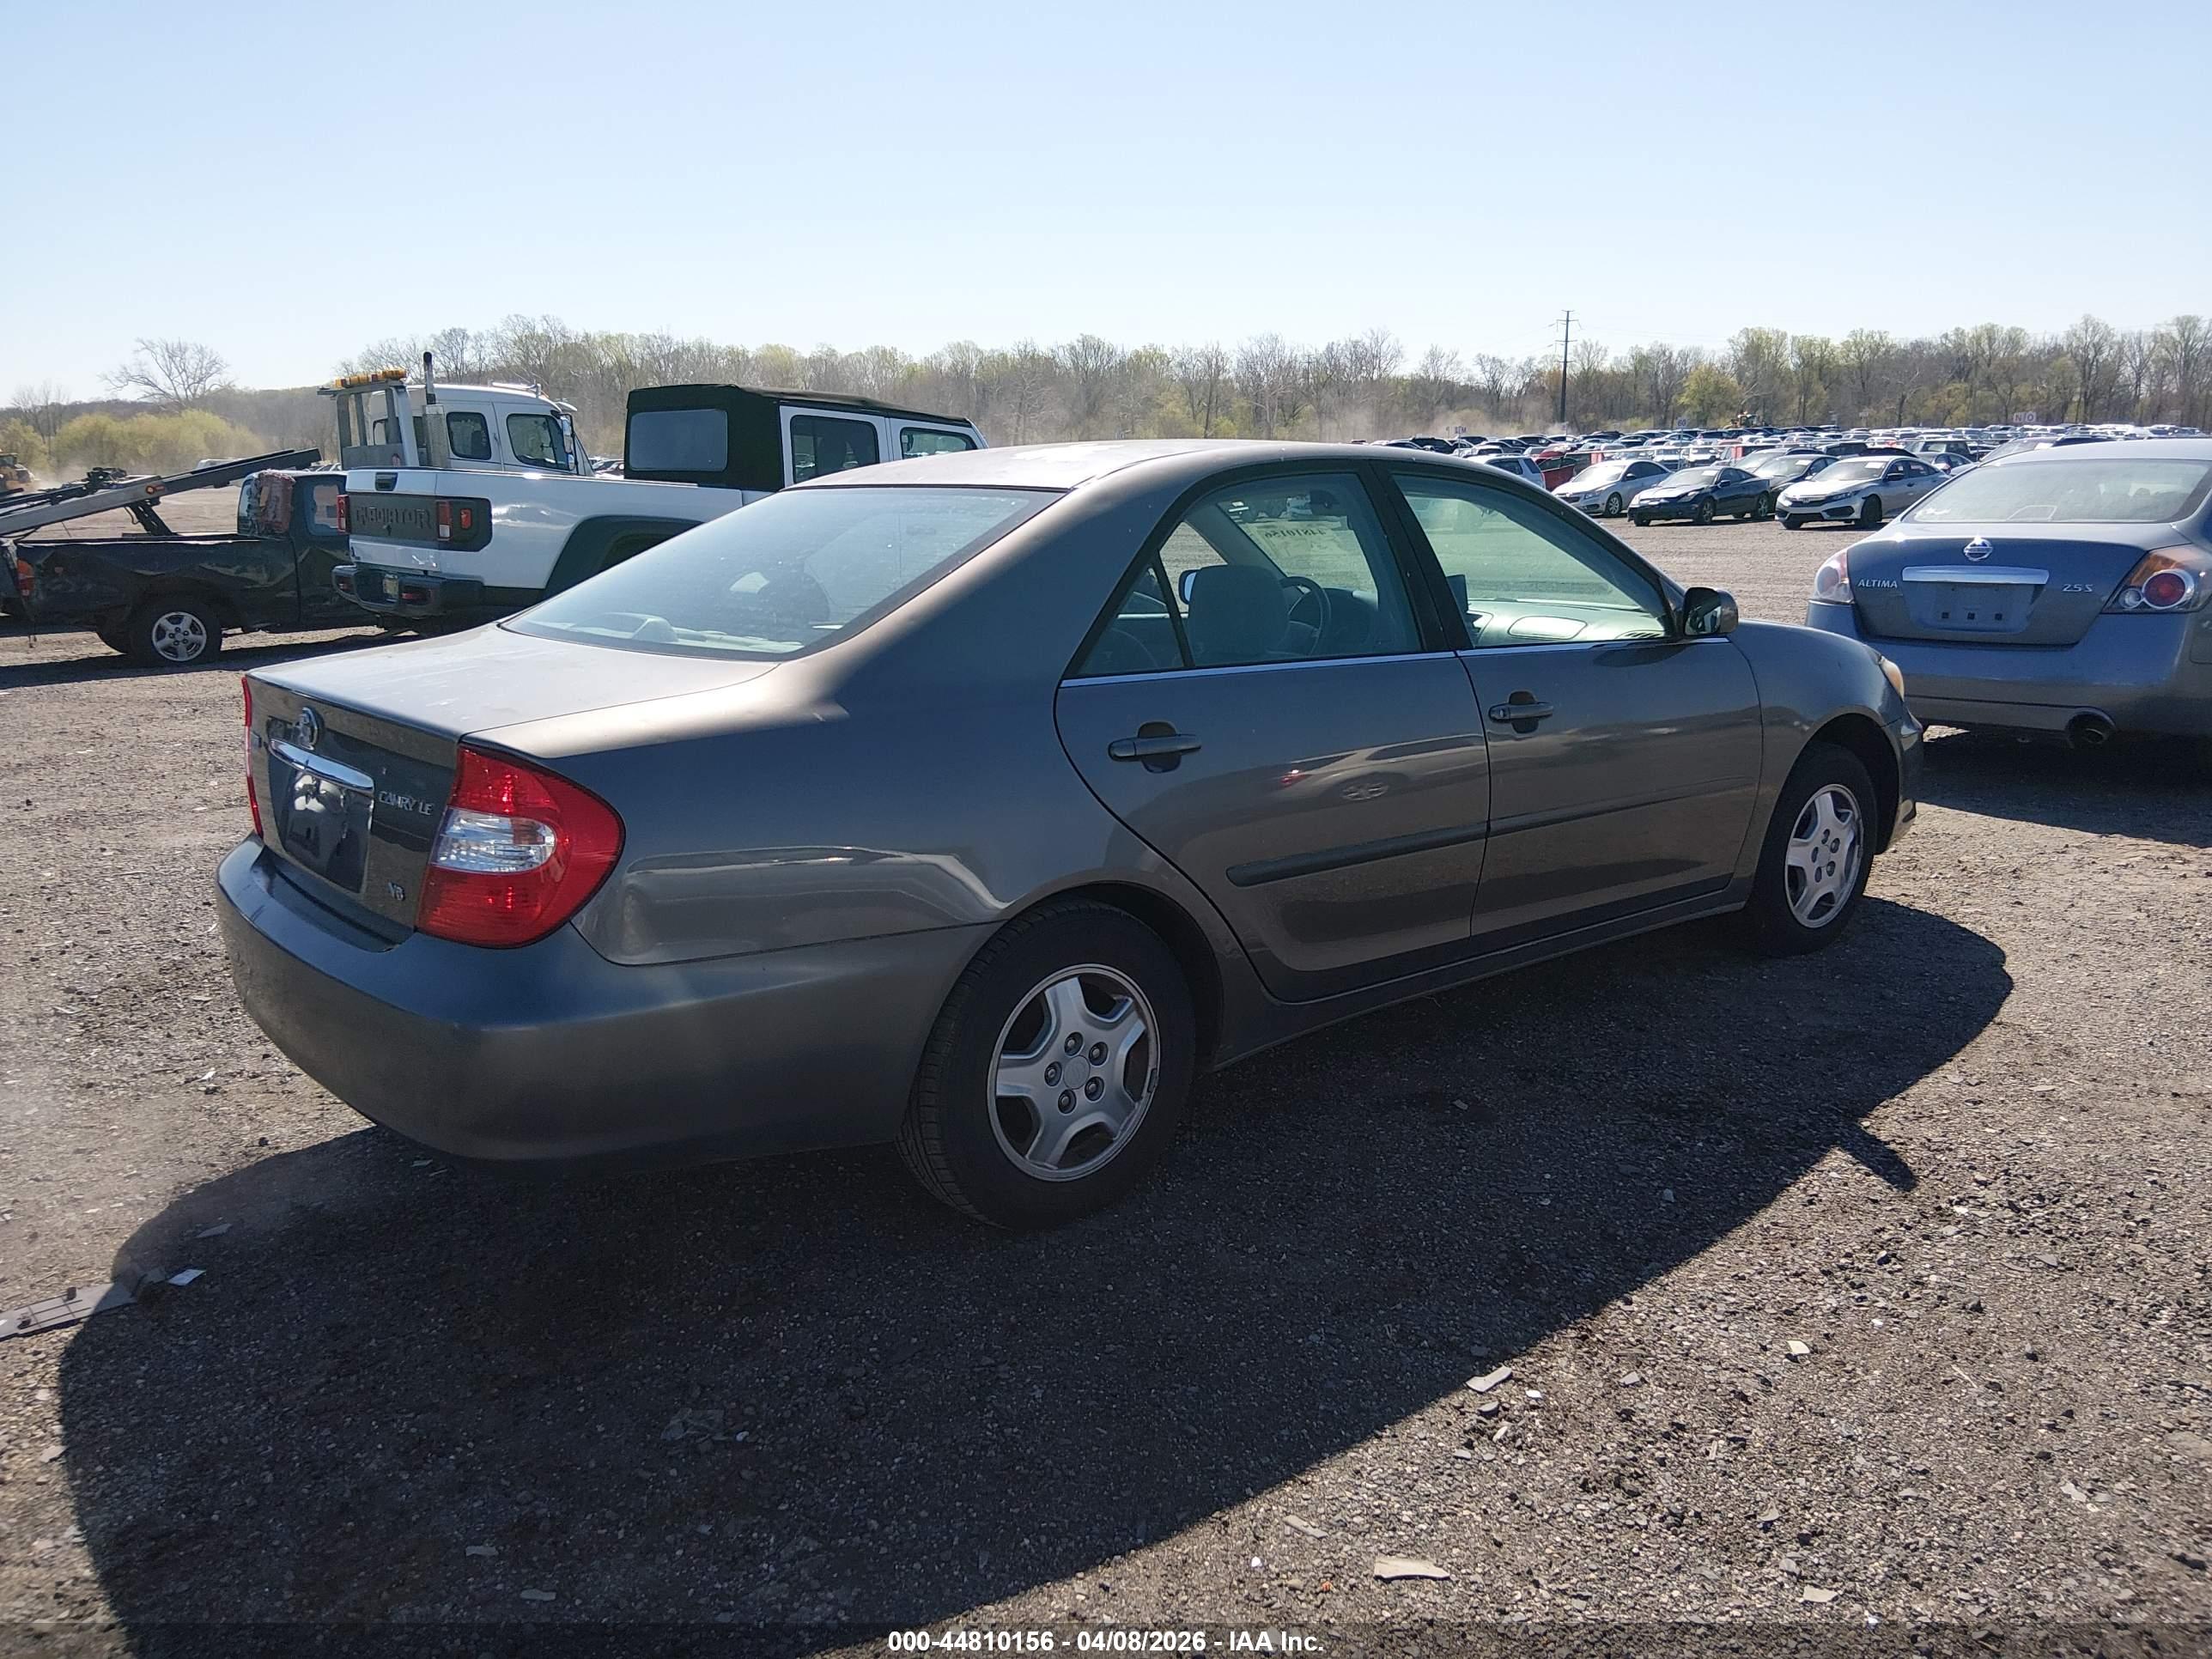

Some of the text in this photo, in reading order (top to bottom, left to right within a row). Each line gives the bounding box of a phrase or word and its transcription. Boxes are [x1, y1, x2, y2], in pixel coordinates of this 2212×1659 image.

[1857, 579, 1898, 588] ALTIMA
[379, 791, 434, 816] CAMRY LE
